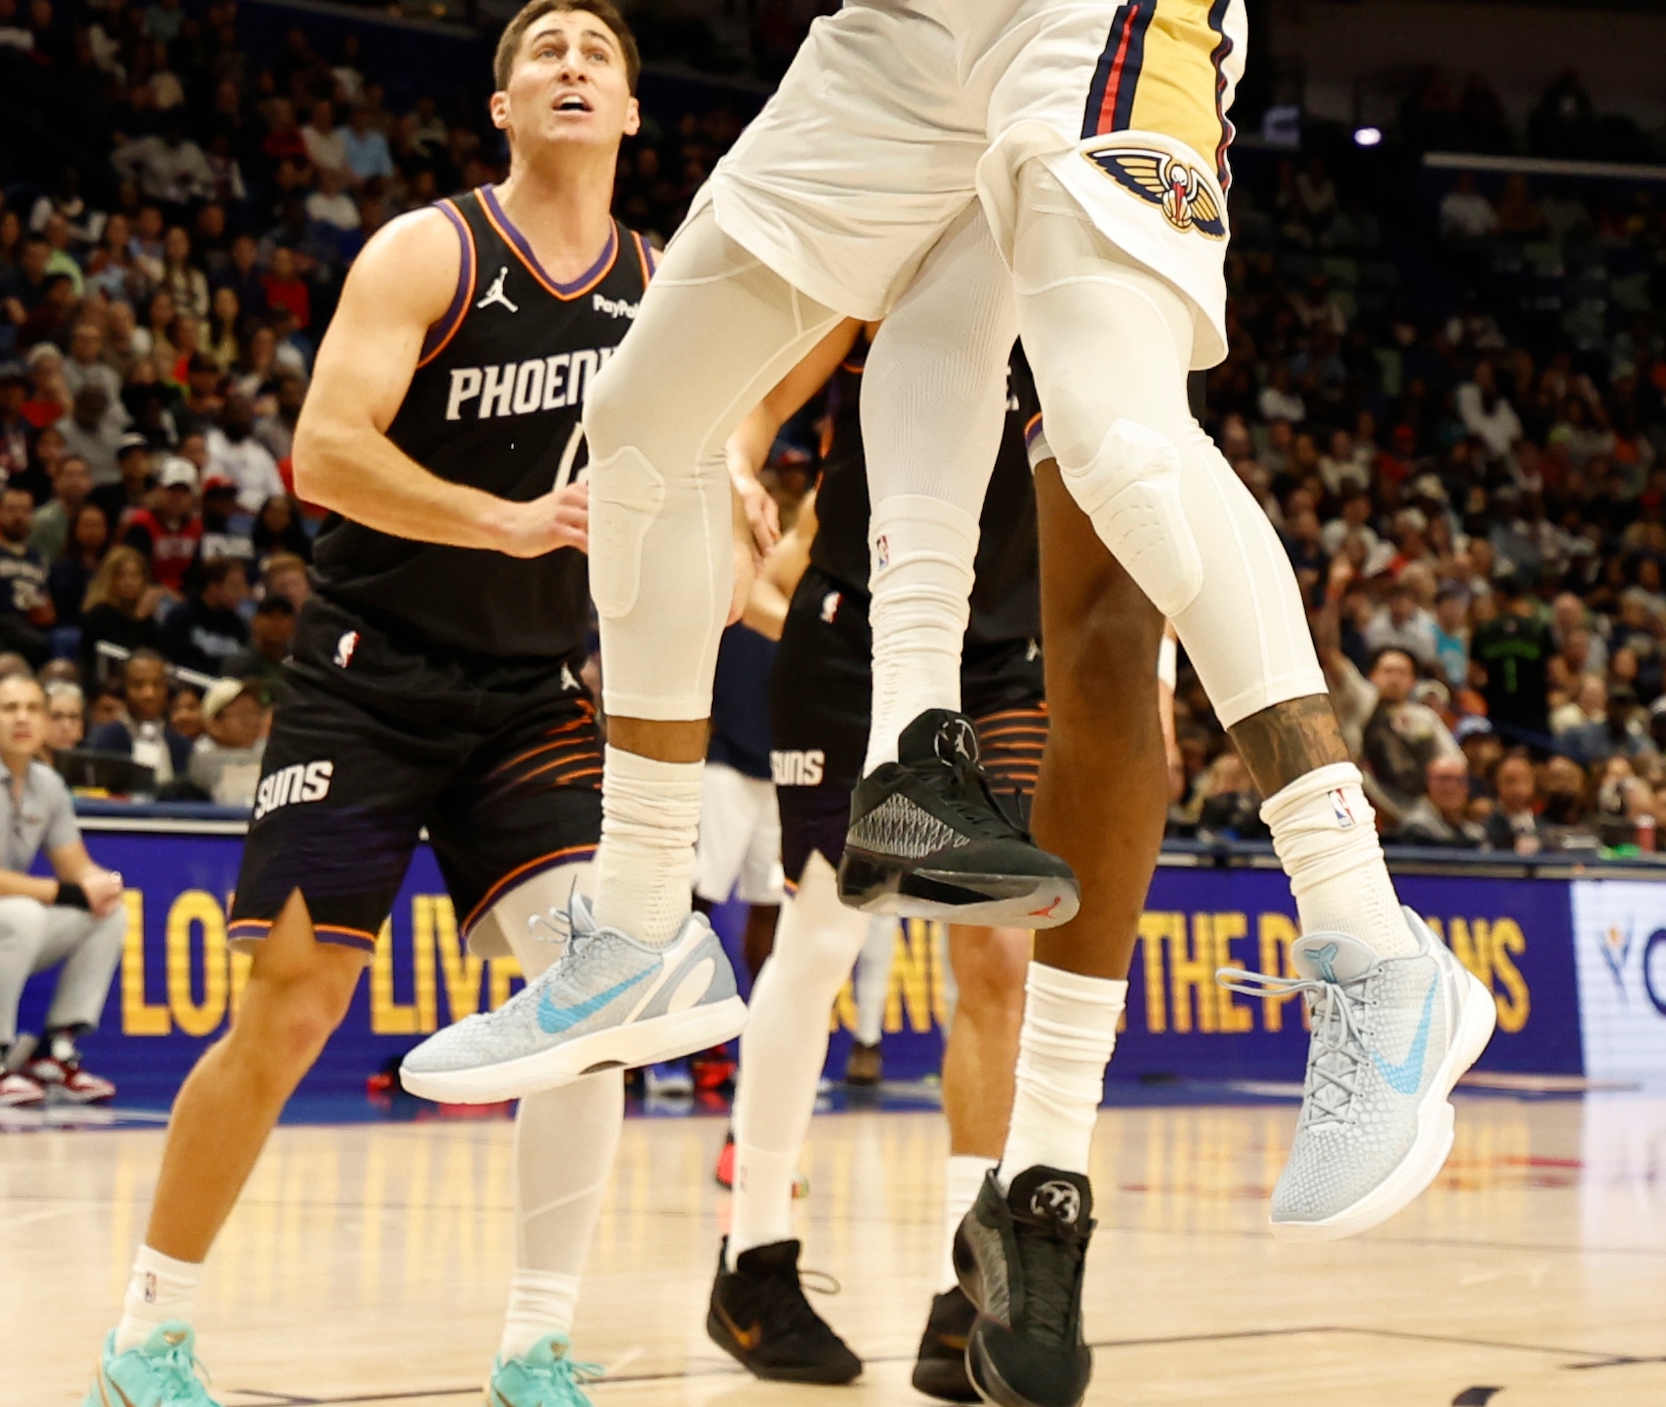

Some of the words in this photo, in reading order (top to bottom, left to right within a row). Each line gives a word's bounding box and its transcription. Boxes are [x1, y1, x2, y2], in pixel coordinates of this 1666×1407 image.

[445, 346, 620, 421] PHOEN
[254, 760, 334, 821] SUNS
[371, 896, 525, 1035] LIV
[1138, 912, 1253, 1033] THE
